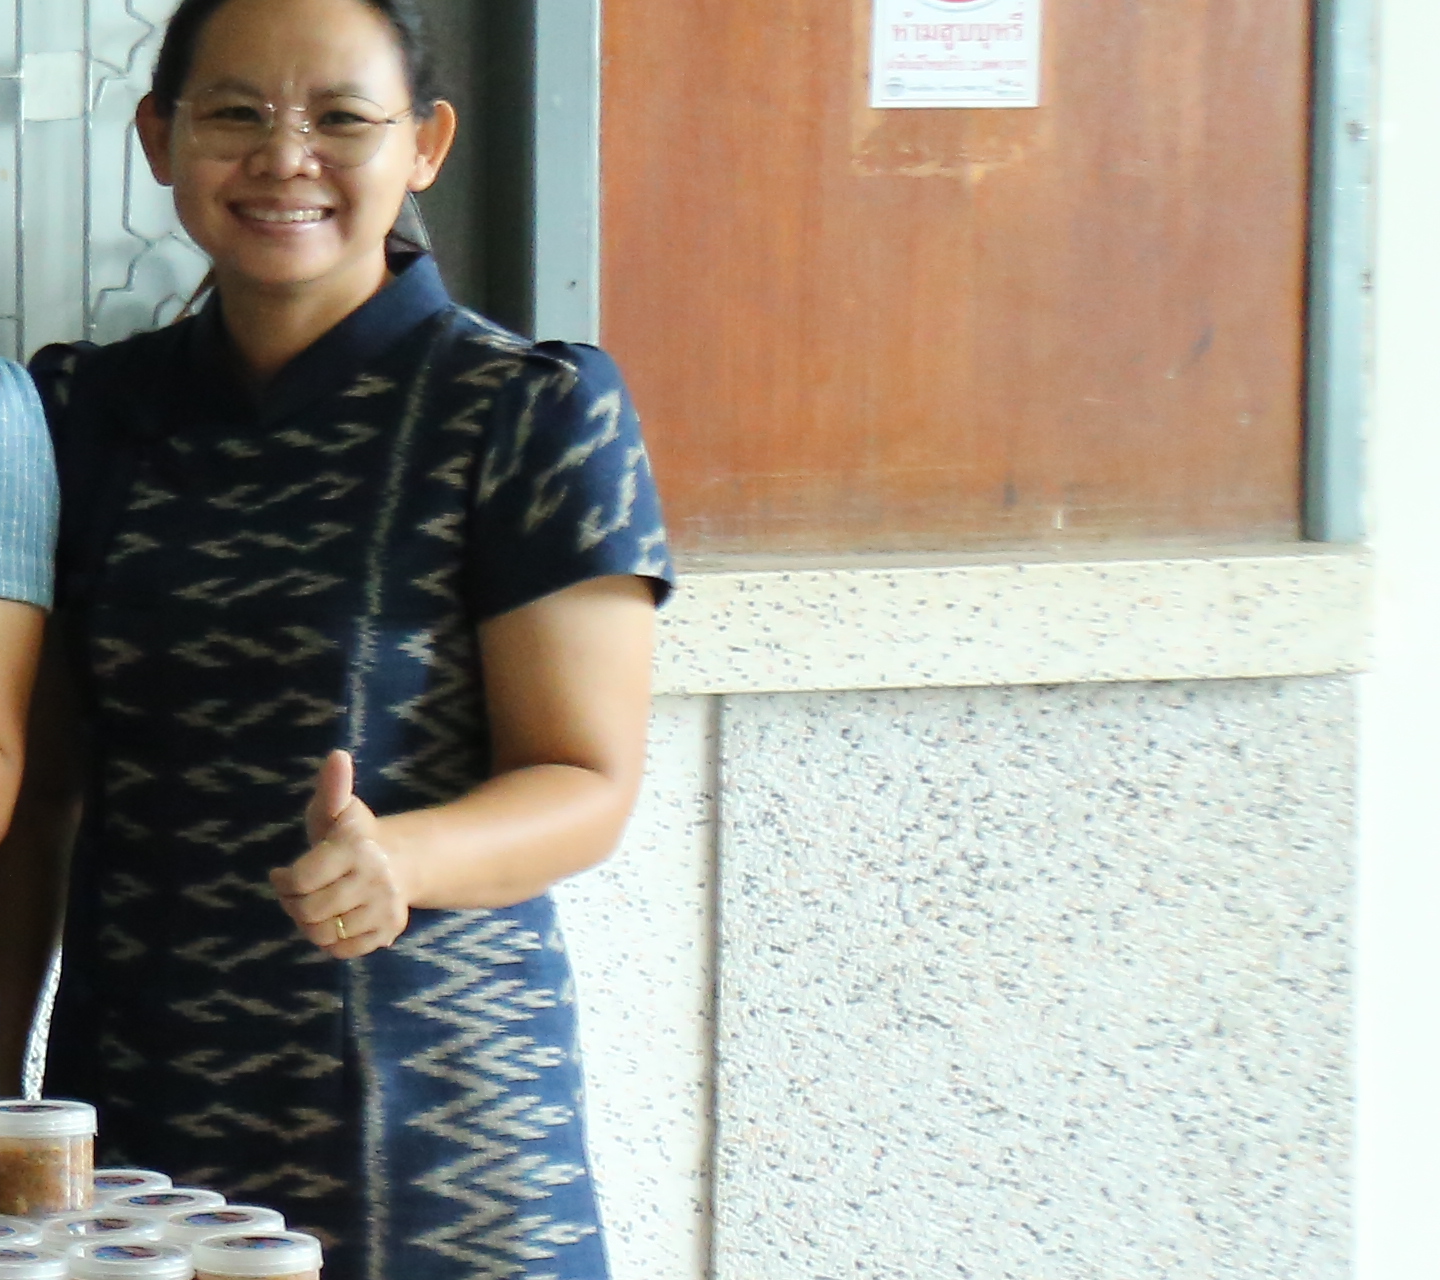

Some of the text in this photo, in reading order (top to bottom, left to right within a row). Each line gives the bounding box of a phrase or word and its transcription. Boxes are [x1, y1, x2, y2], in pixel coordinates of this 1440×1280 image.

[891, 2, 1024, 50] ห้ามสูบบุหรี่
